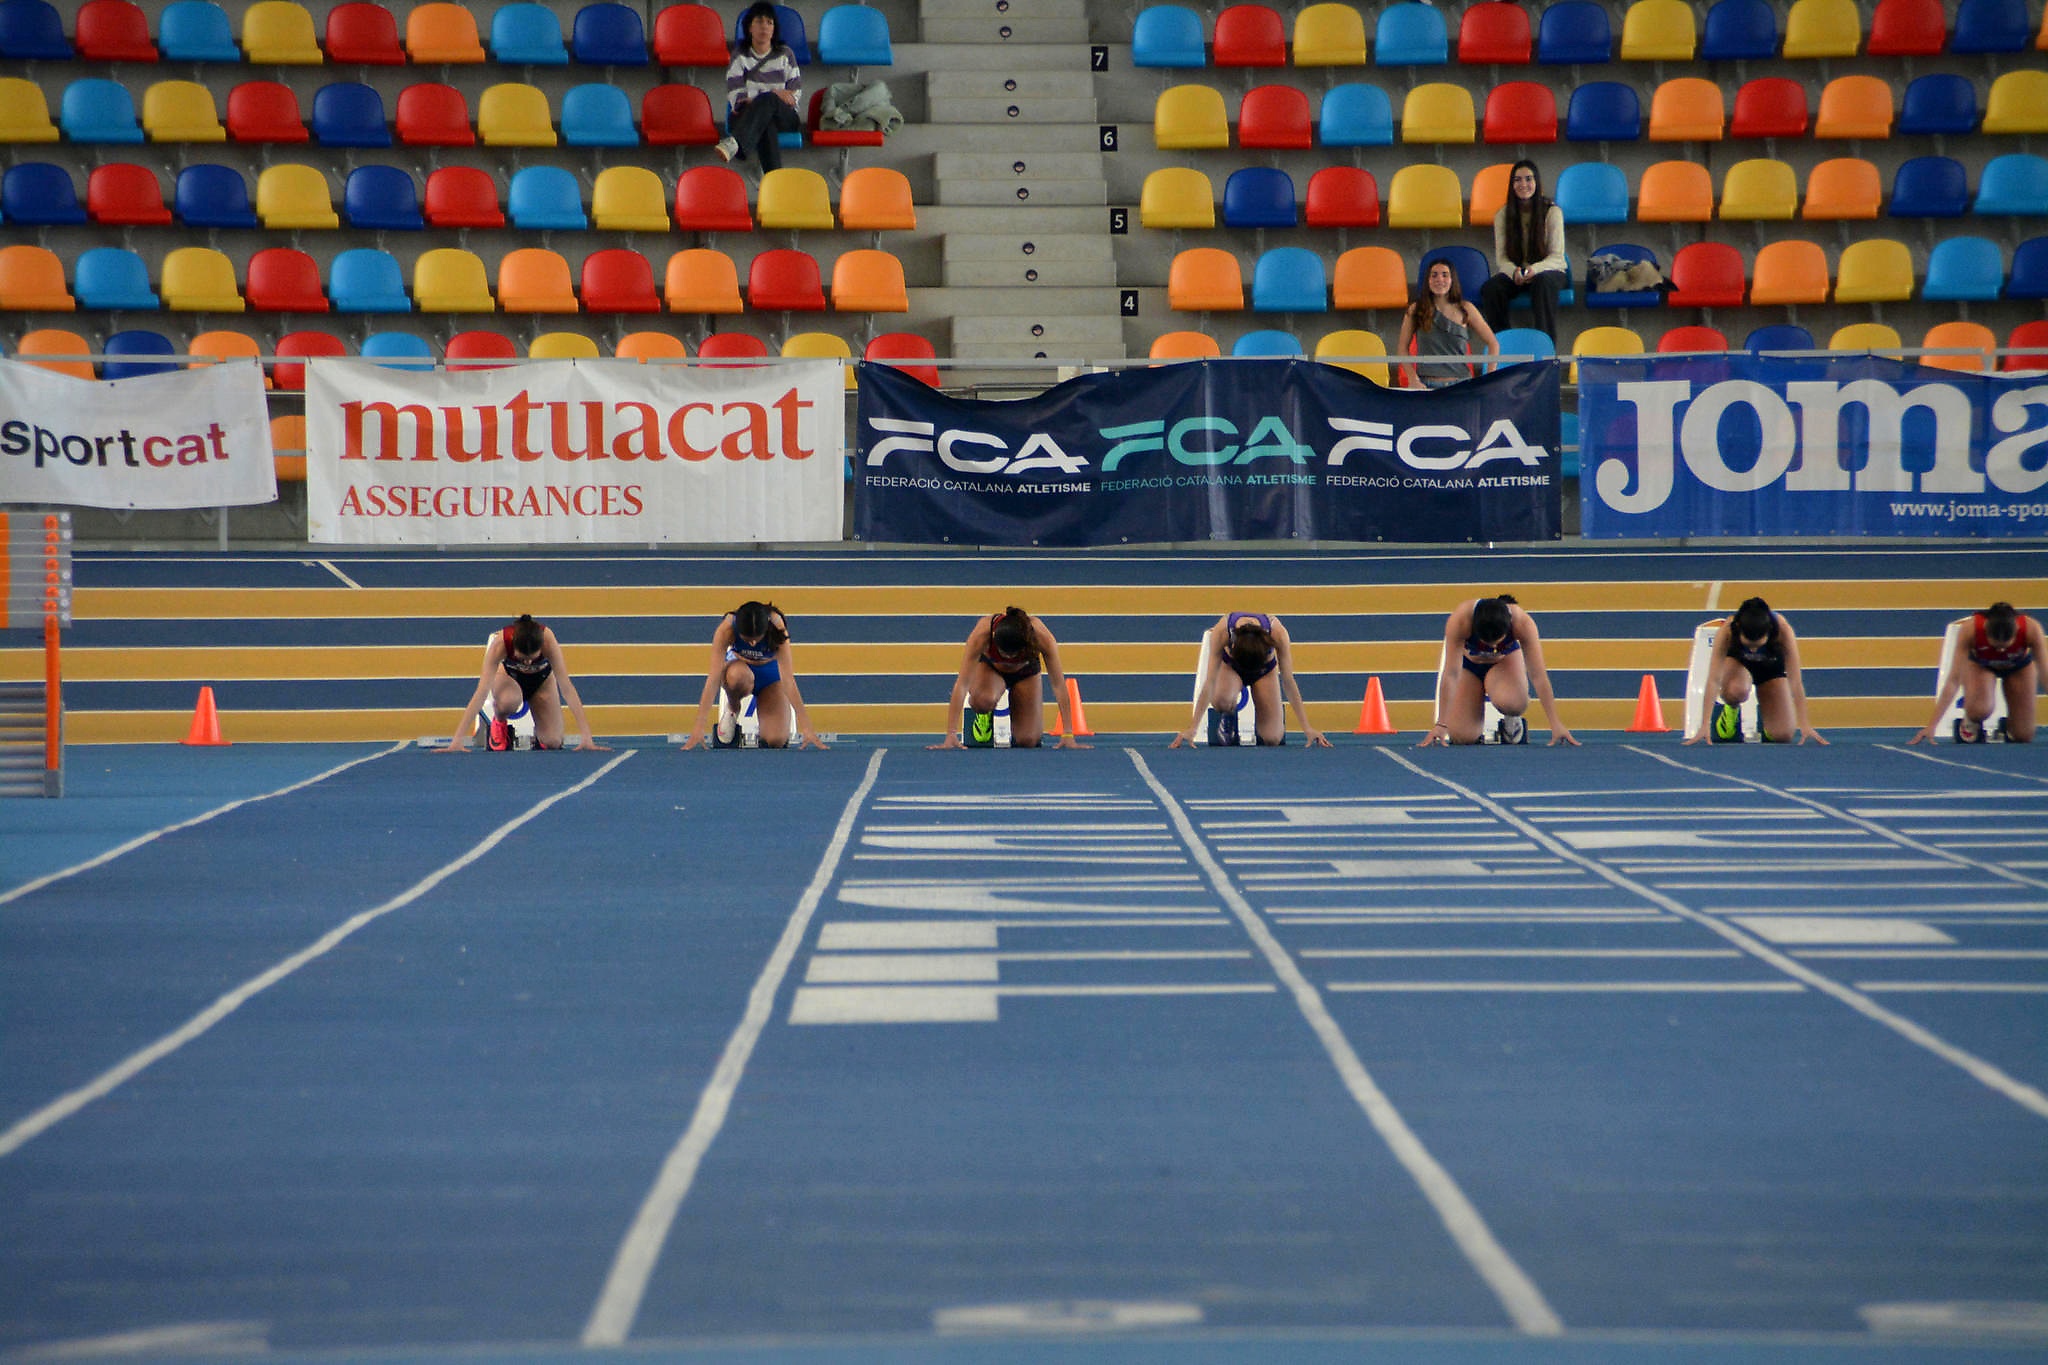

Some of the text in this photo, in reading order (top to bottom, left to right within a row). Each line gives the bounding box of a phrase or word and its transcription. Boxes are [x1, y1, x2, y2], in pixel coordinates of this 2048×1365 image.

[1095, 52, 1104, 66] 7
[1104, 132, 1114, 146] 6
[1114, 214, 1124, 228] 5
[1124, 296, 1135, 310] 4
[339, 387, 814, 463] mutuacat
[1, 421, 230, 468] sportcat
[866, 417, 1090, 474] FCA
[1099, 416, 1316, 472] FCA
[1327, 417, 1549, 470] FCA
[865, 475, 1091, 494] FEDERACIÓ CATALANA ATLETISME
[1101, 473, 1317, 491] FEDERACIÓ CATALANA ATLETISME
[1326, 475, 1550, 489] FEDERACIÓ CATALANA ATLETISME
[338, 485, 643, 518] ASSEGURANCES
